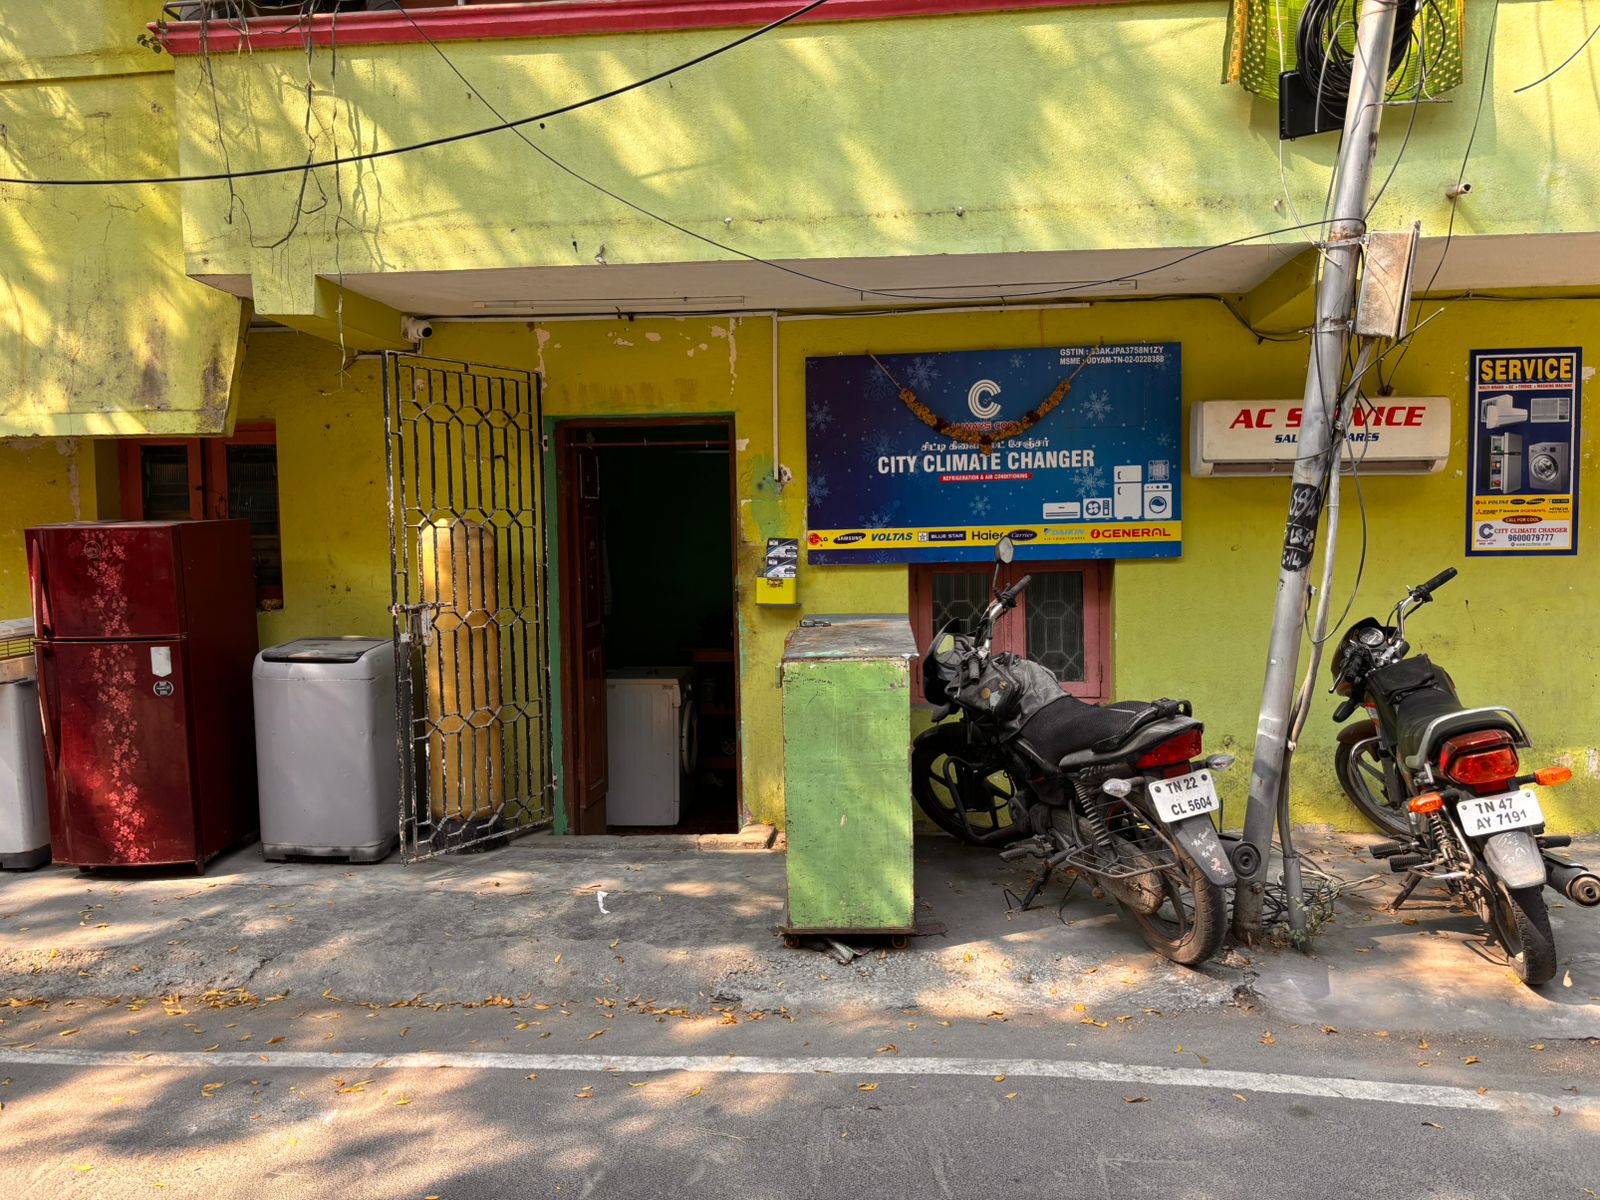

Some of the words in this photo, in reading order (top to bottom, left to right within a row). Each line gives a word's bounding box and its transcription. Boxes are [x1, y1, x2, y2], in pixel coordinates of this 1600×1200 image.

[1060, 348, 1084, 356] GSTIN
[1060, 357, 1081, 365] MSME
[1481, 358, 1572, 381] SERVICE
[1229, 408, 1276, 429] AC
[1285, 406, 1426, 428] SVICE
[878, 455, 917, 474] CITY
[923, 453, 1001, 473] CLIMATE
[1007, 449, 1095, 470] CHANGER
[871, 532, 913, 541] VOLTAS
[972, 530, 1004, 541] Haier
[1102, 528, 1171, 538] GENERAL
[1507, 534, 1554, 542] 9600079777
[1165, 781, 1183, 794] TN
[1183, 777, 1198, 790] 22
[1171, 803, 1187, 816] CL
[1187, 796, 1213, 812] 5604
[1475, 801, 1495, 814] TN
[1498, 797, 1513, 810] 47
[1476, 816, 1492, 831] AY
[1496, 808, 1528, 826] 7191
